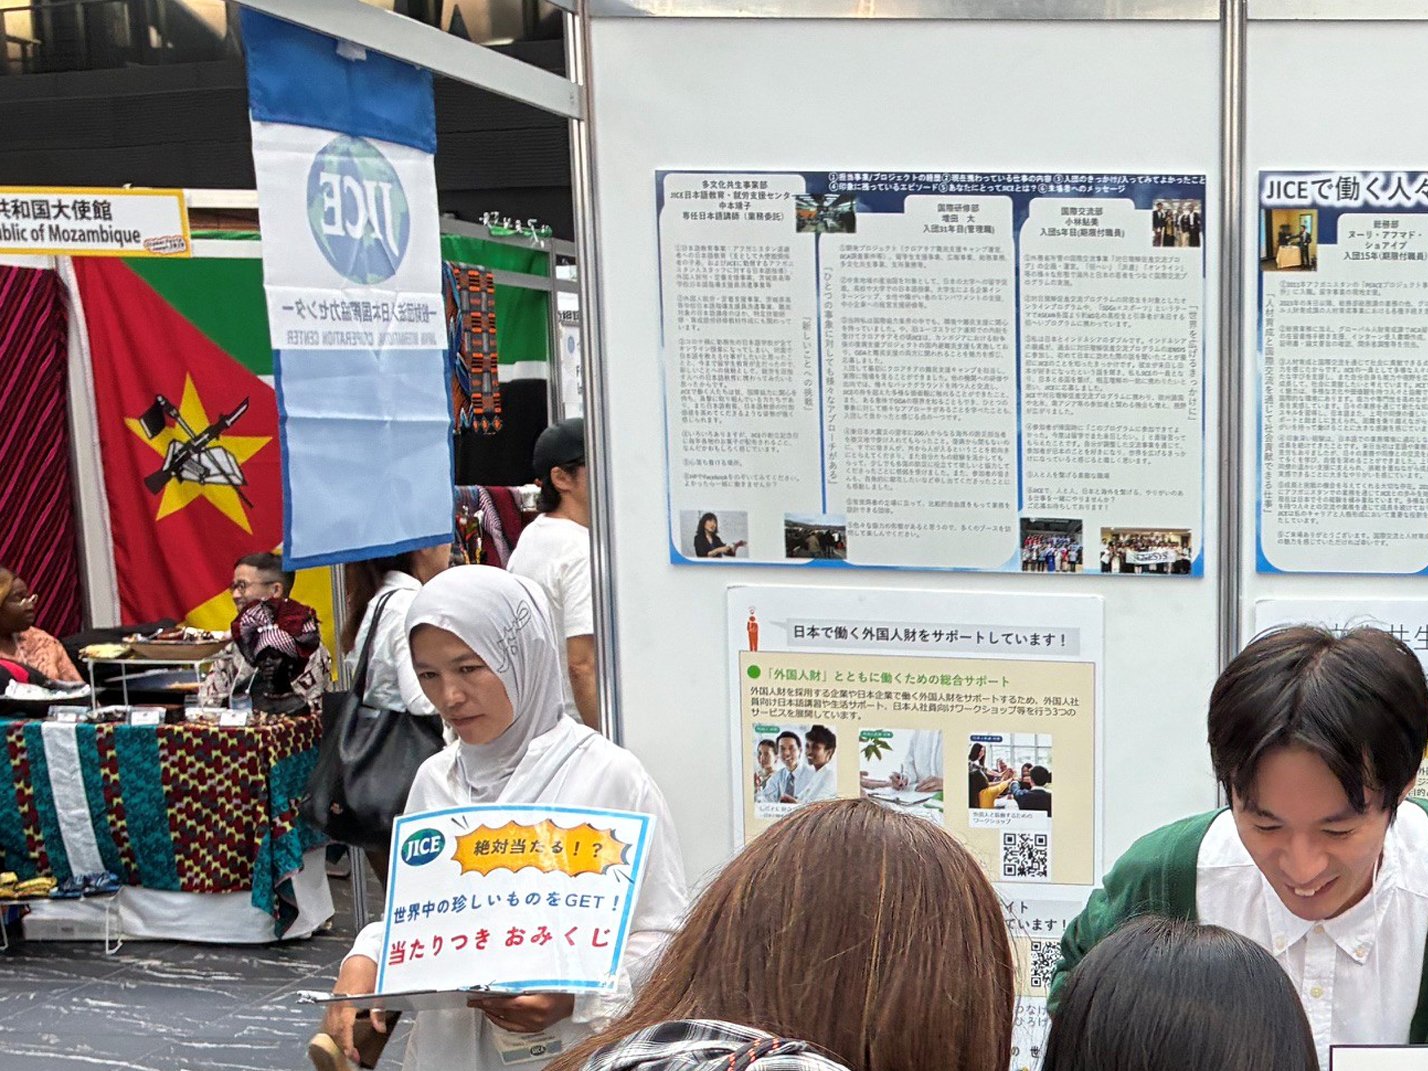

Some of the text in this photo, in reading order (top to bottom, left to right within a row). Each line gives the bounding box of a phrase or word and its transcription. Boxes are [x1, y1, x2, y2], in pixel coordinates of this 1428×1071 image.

[0, 223, 141, 247] blic of Mozambique
[793, 624, 1068, 647] 日本で働く外国人財をサポートしています！
[766, 667, 1010, 688] 「外国人財」とともに働くための総合サポート
[404, 834, 443, 862] JICE
[473, 837, 603, 858] 絶対当たる！？
[393, 890, 619, 925] 世界中の珍しいものをGET！
[387, 926, 611, 966] 当たりつき おみくじ
